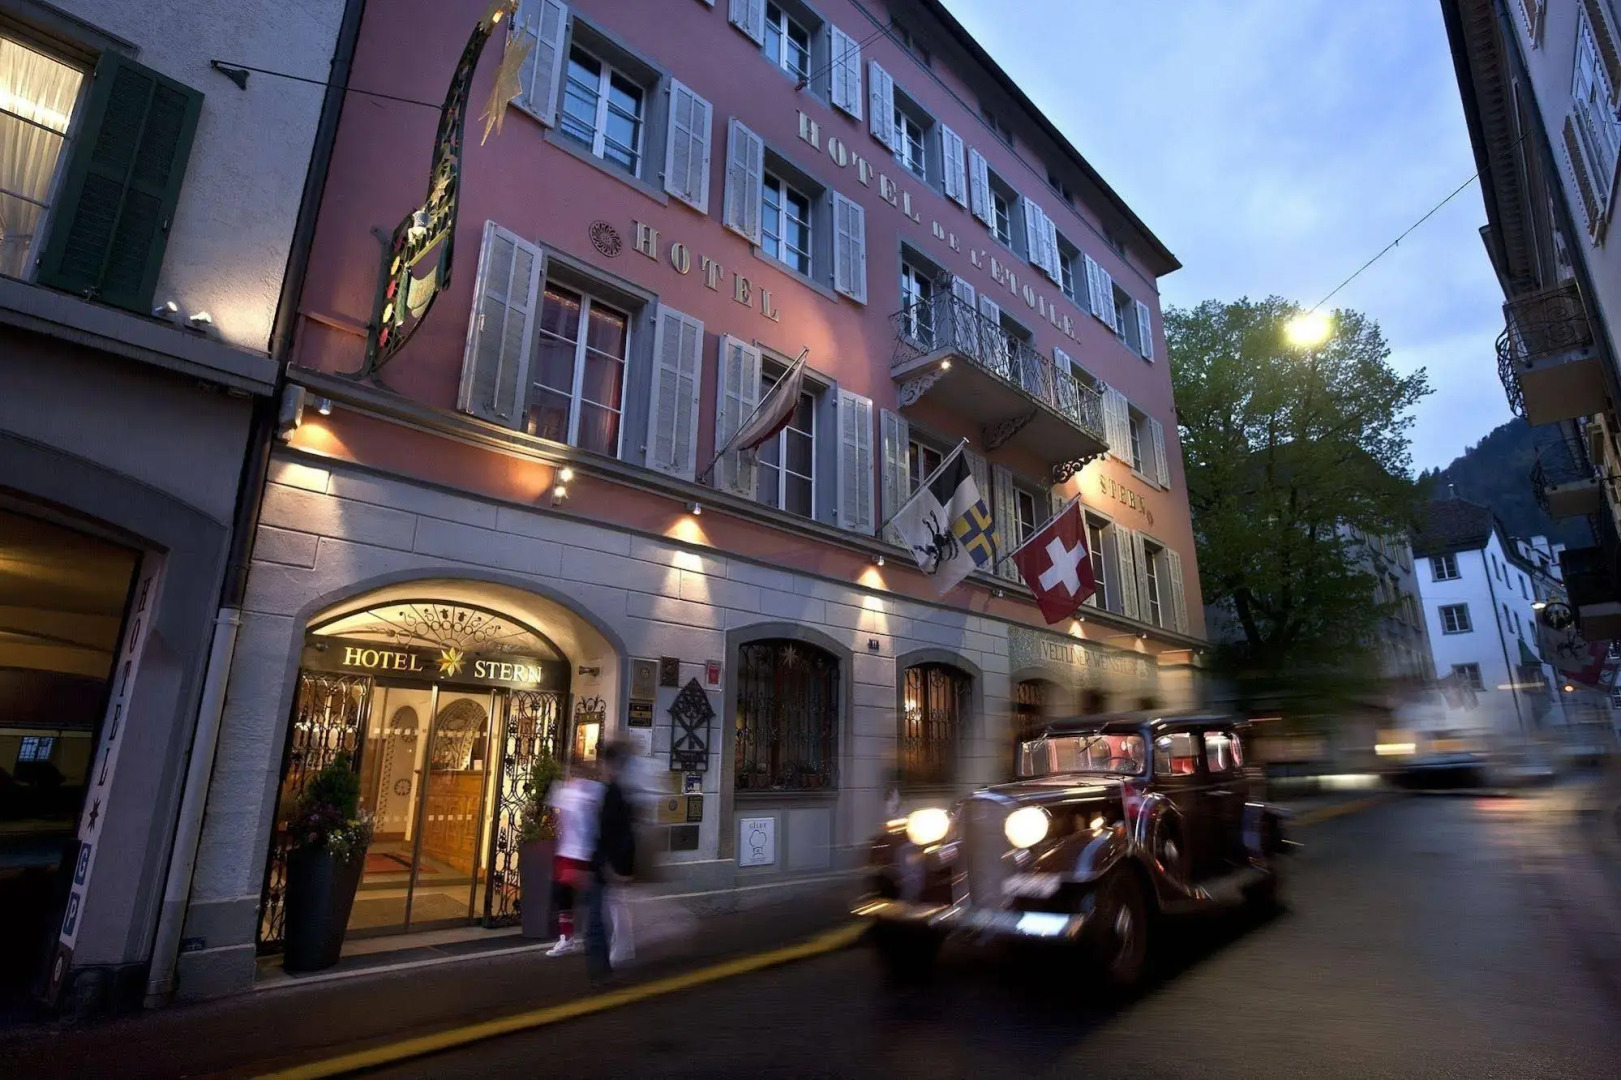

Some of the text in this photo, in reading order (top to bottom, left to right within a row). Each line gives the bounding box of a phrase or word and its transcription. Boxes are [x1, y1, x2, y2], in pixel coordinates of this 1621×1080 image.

[796, 109, 920, 225] HOTEL
[932, 219, 961, 254] DE
[632, 219, 780, 323] HOTEL
[1100, 474, 1146, 516] STERN
[98, 577, 153, 787] HOTEL
[342, 647, 543, 684] HOTEL STERN
[1042, 640, 1090, 665] VELTLINER
